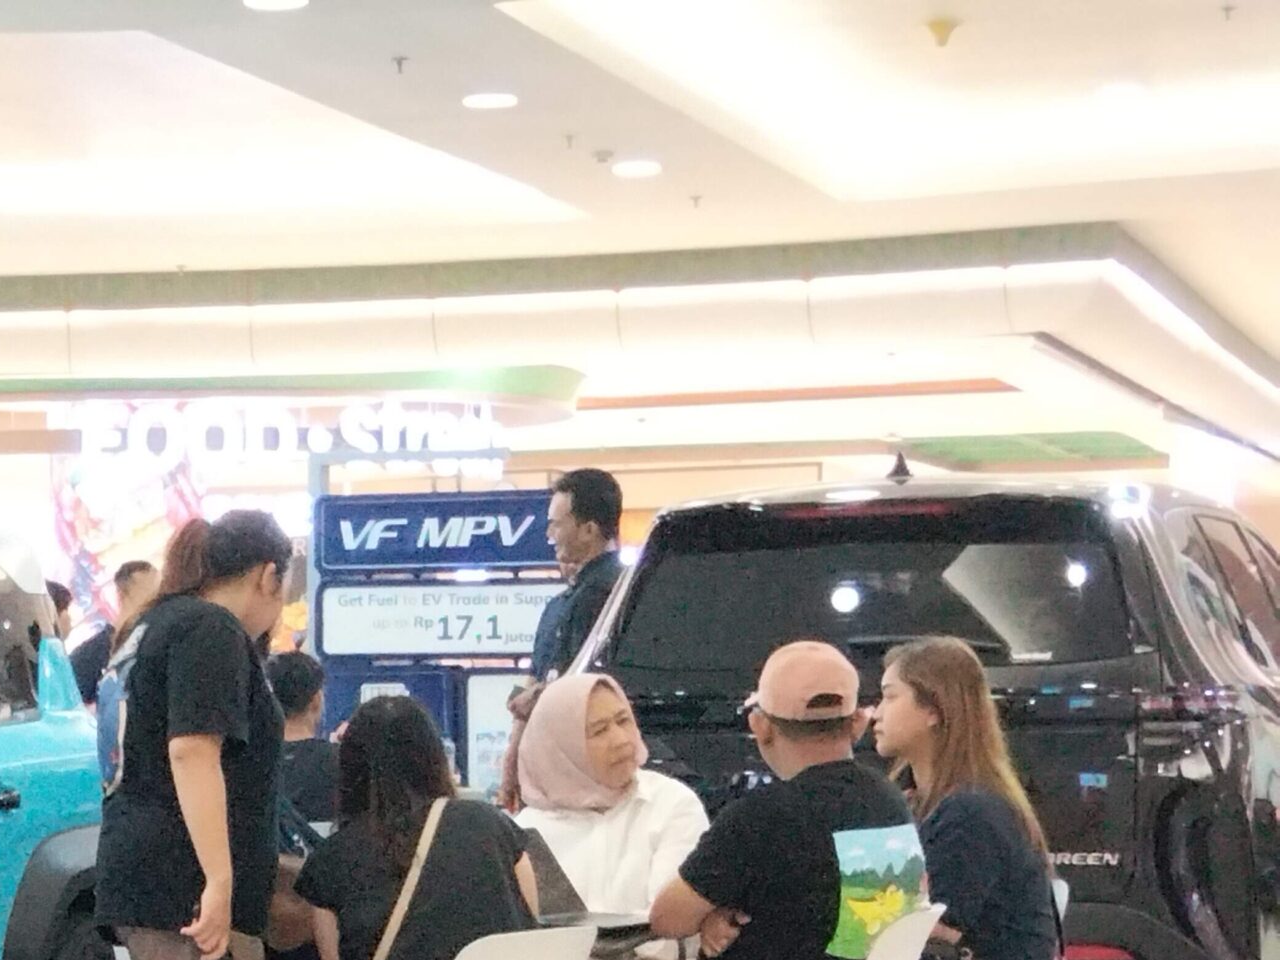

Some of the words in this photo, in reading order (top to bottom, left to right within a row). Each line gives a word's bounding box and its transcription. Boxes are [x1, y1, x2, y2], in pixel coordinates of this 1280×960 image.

[339, 518, 408, 550] VF
[416, 515, 535, 549] MPV
[337, 593, 363, 608] Get
[368, 592, 398, 606] Fuel
[422, 591, 442, 605] EV
[448, 591, 490, 605] Trade
[495, 590, 508, 605] in
[414, 616, 434, 631] Rp
